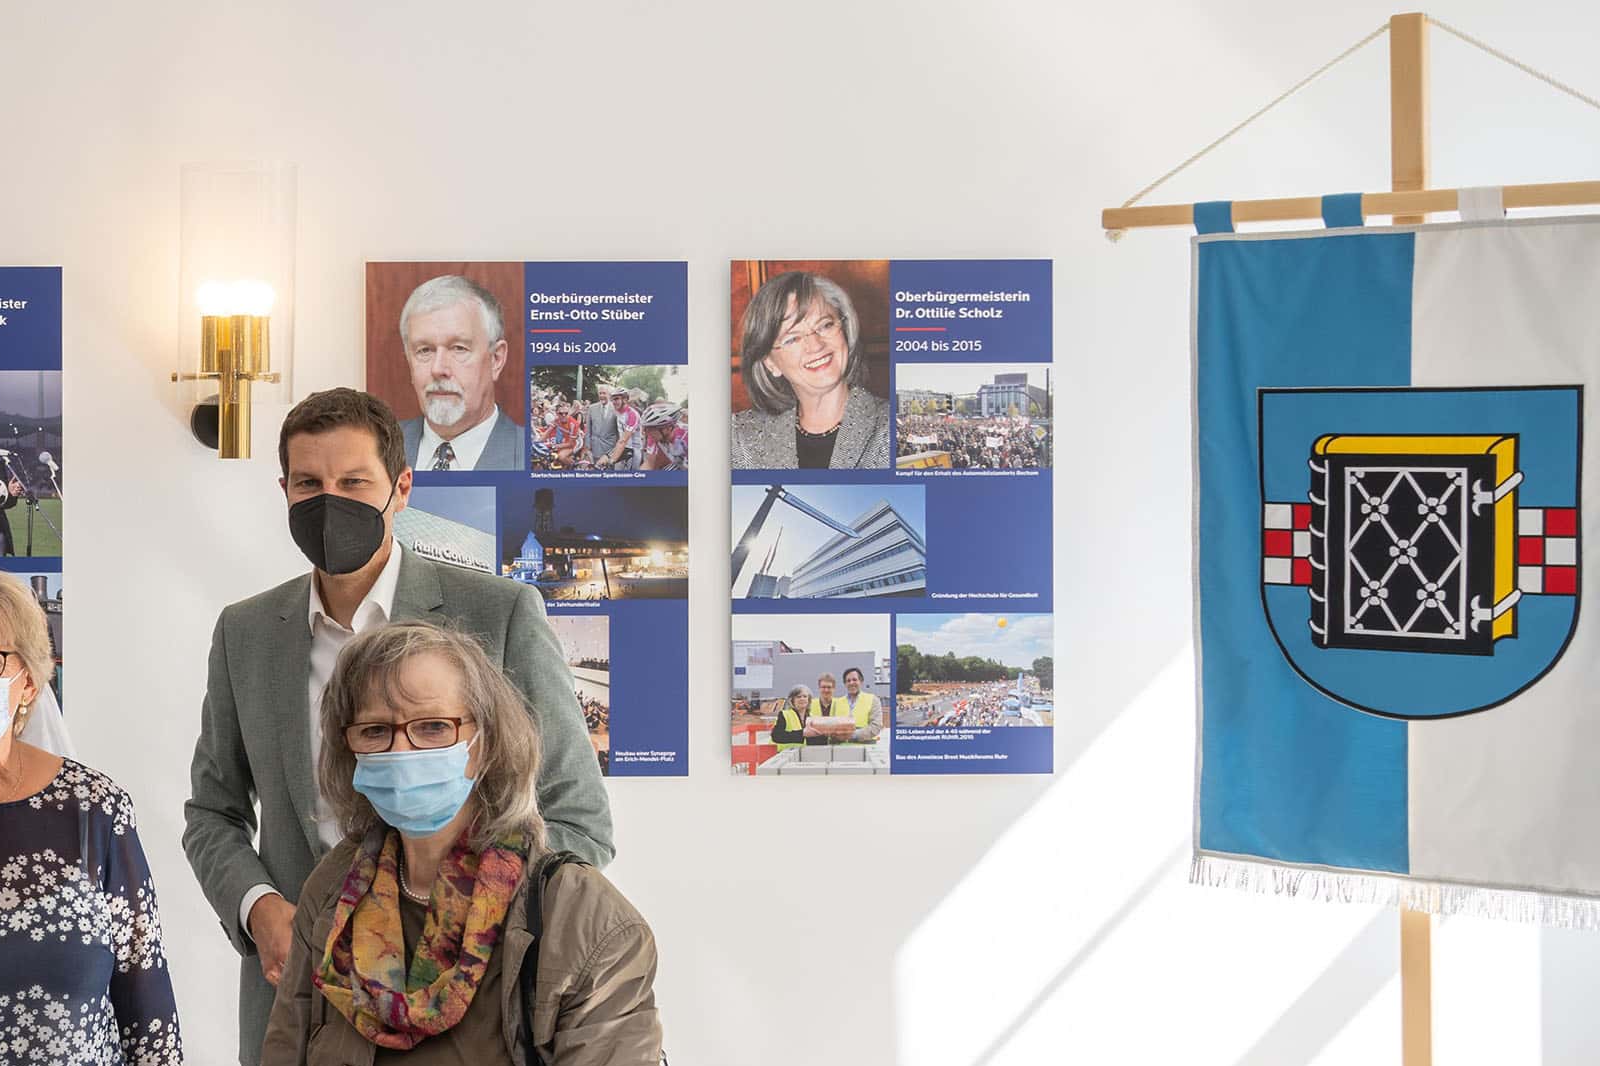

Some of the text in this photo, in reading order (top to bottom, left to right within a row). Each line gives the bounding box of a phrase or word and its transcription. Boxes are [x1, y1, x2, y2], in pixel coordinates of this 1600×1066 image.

[530, 293, 654, 305] Oberbürgermeister
[895, 291, 1031, 304] Oberbürgermeisterin
[530, 309, 646, 321] Ernst-Otto Stüber
[895, 307, 1003, 319] Dr. Ottilie Scholz
[530, 341, 617, 353] 1994 bis 2004
[895, 340, 982, 352] 2004 bis 2015
